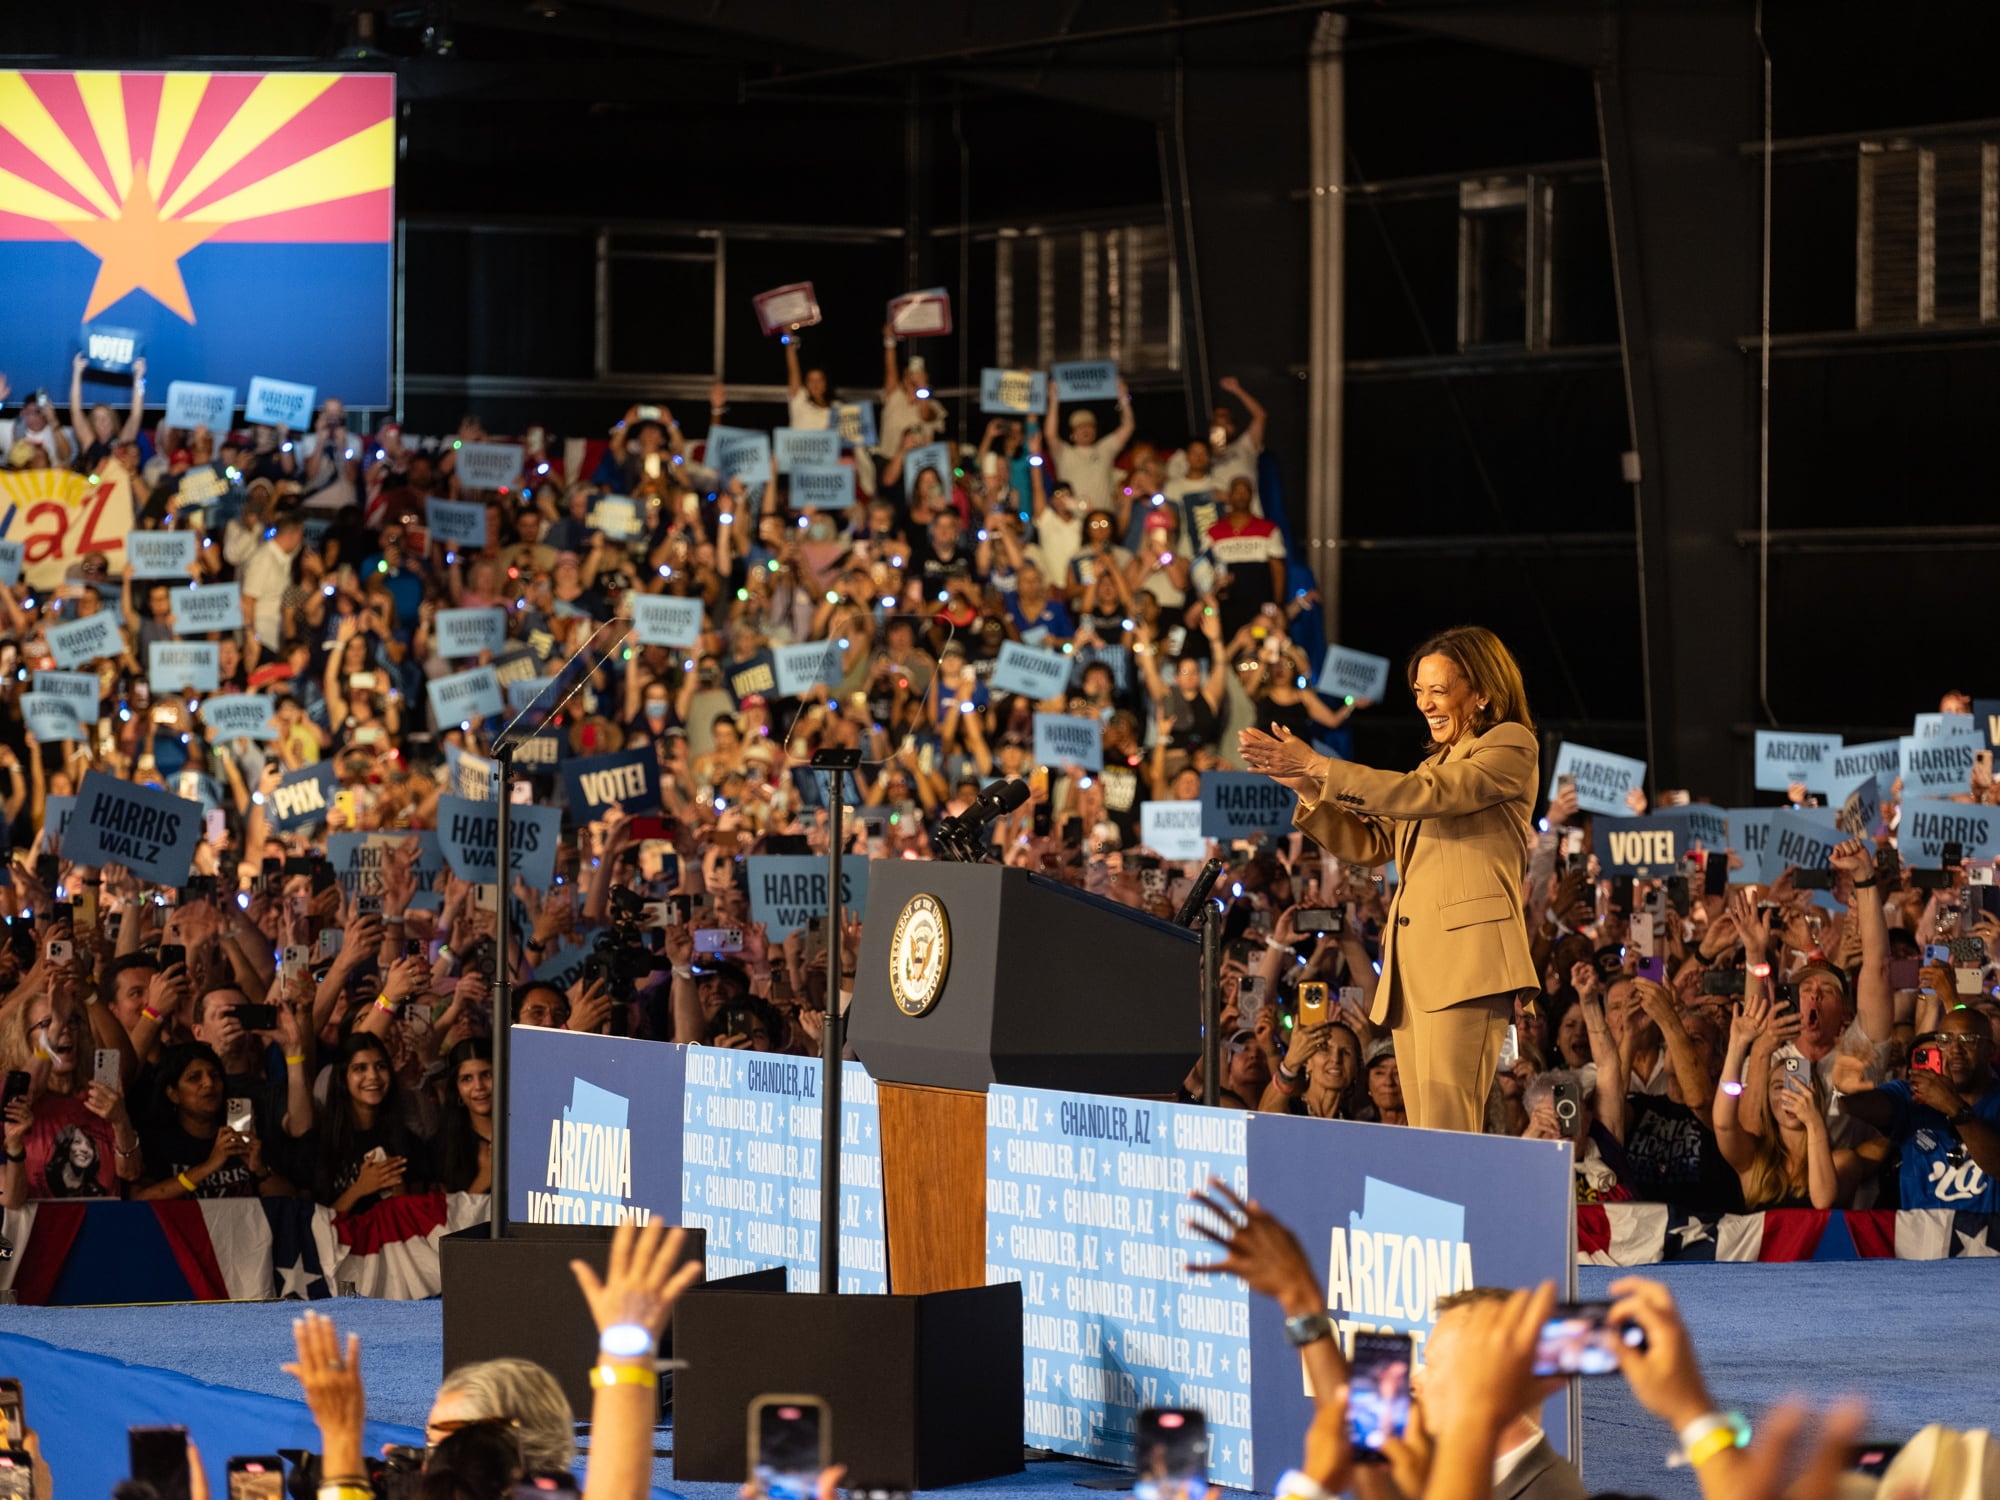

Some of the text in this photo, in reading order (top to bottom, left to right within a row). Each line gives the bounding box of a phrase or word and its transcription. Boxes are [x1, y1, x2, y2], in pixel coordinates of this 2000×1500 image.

[1569, 756, 1633, 792] HARRIS
[1835, 748, 1900, 780] ARIZONA
[1908, 744, 1973, 772] HARRIS
[579, 762, 649, 807] VOTE!
[1919, 770, 1965, 786] WALZ
[274, 778, 326, 820] PHX
[1216, 784, 1291, 809] HARRIS
[89, 793, 182, 848] HARRIS
[1227, 810, 1280, 828] WALZ
[1912, 812, 1989, 845] HARRIS
[97, 834, 161, 867] WALZ
[463, 848, 524, 870] WAZ
[1608, 830, 1676, 866] VOTE!
[1778, 828, 1834, 871] HARR
[1922, 841, 1976, 859] WZ
[764, 873, 851, 905] HARRS
[546, 1119, 631, 1199] ARIZONA
[1328, 1226, 1474, 1324] ARIZONA
[1177, 1293, 1250, 1338] CHANDLER
